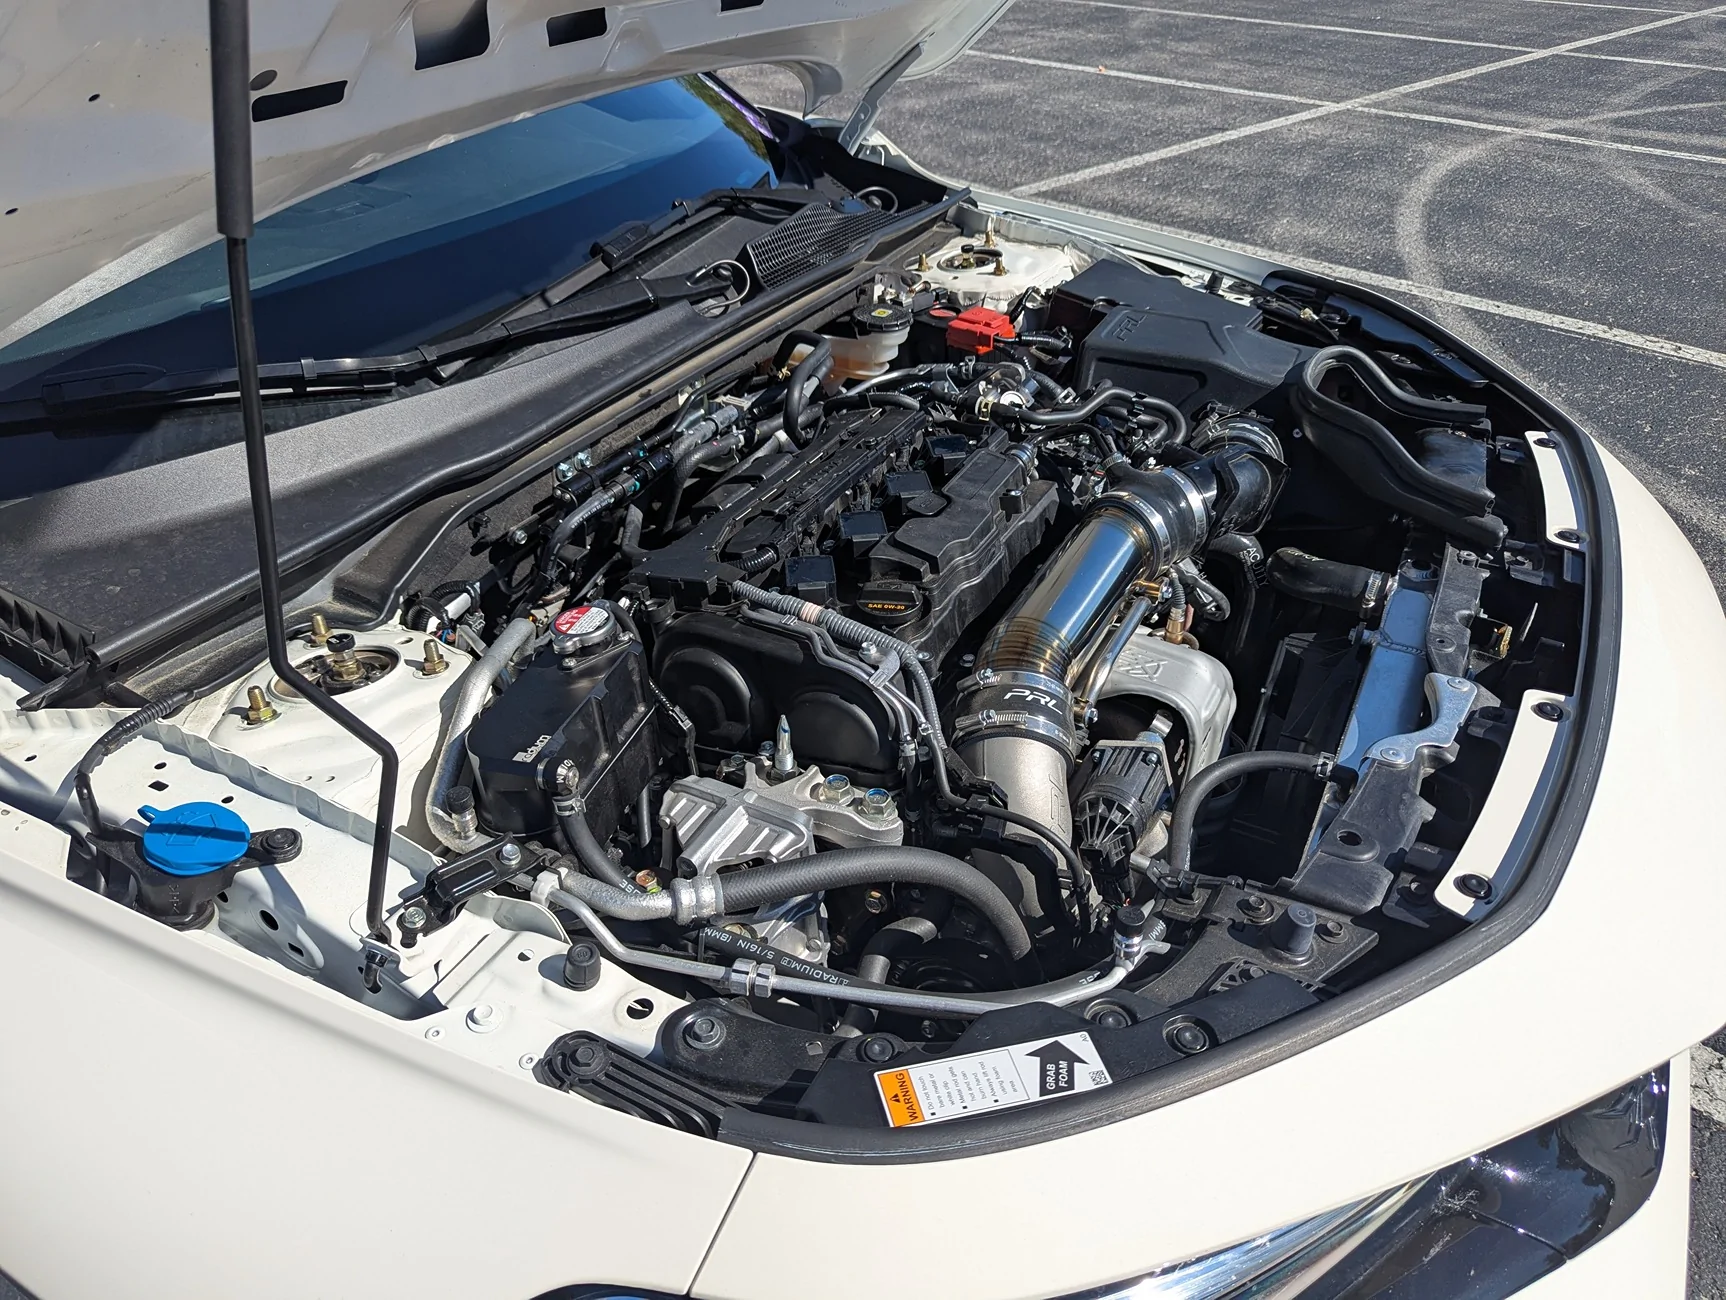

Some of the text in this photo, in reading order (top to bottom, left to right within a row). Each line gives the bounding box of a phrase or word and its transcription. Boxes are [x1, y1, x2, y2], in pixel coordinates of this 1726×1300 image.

[1246, 547, 1269, 586] ACUITY
[1003, 688, 1063, 715] PRL
[736, 939, 776, 960] 5/16IN
[791, 962, 839, 985] RADIUM
[978, 1060, 987, 1071] rod
[1046, 1063, 1056, 1090] GRAB
[1058, 1060, 1069, 1087] FOAM
[918, 1076, 935, 1110] Do not touch
[931, 1080, 940, 1095] metal
[942, 1080, 956, 1106] white clip
[948, 1066, 966, 1104] Metal rod gets
[960, 1070, 976, 1102] hot and can
[972, 1072, 987, 1100] burn hand
[985, 1077, 998, 1097] Always
[991, 1065, 1008, 1096] using foam
[1009, 1080, 1018, 1093] area
[896, 1073, 918, 1121] WARNING
[936, 1095, 945, 1108] bare
